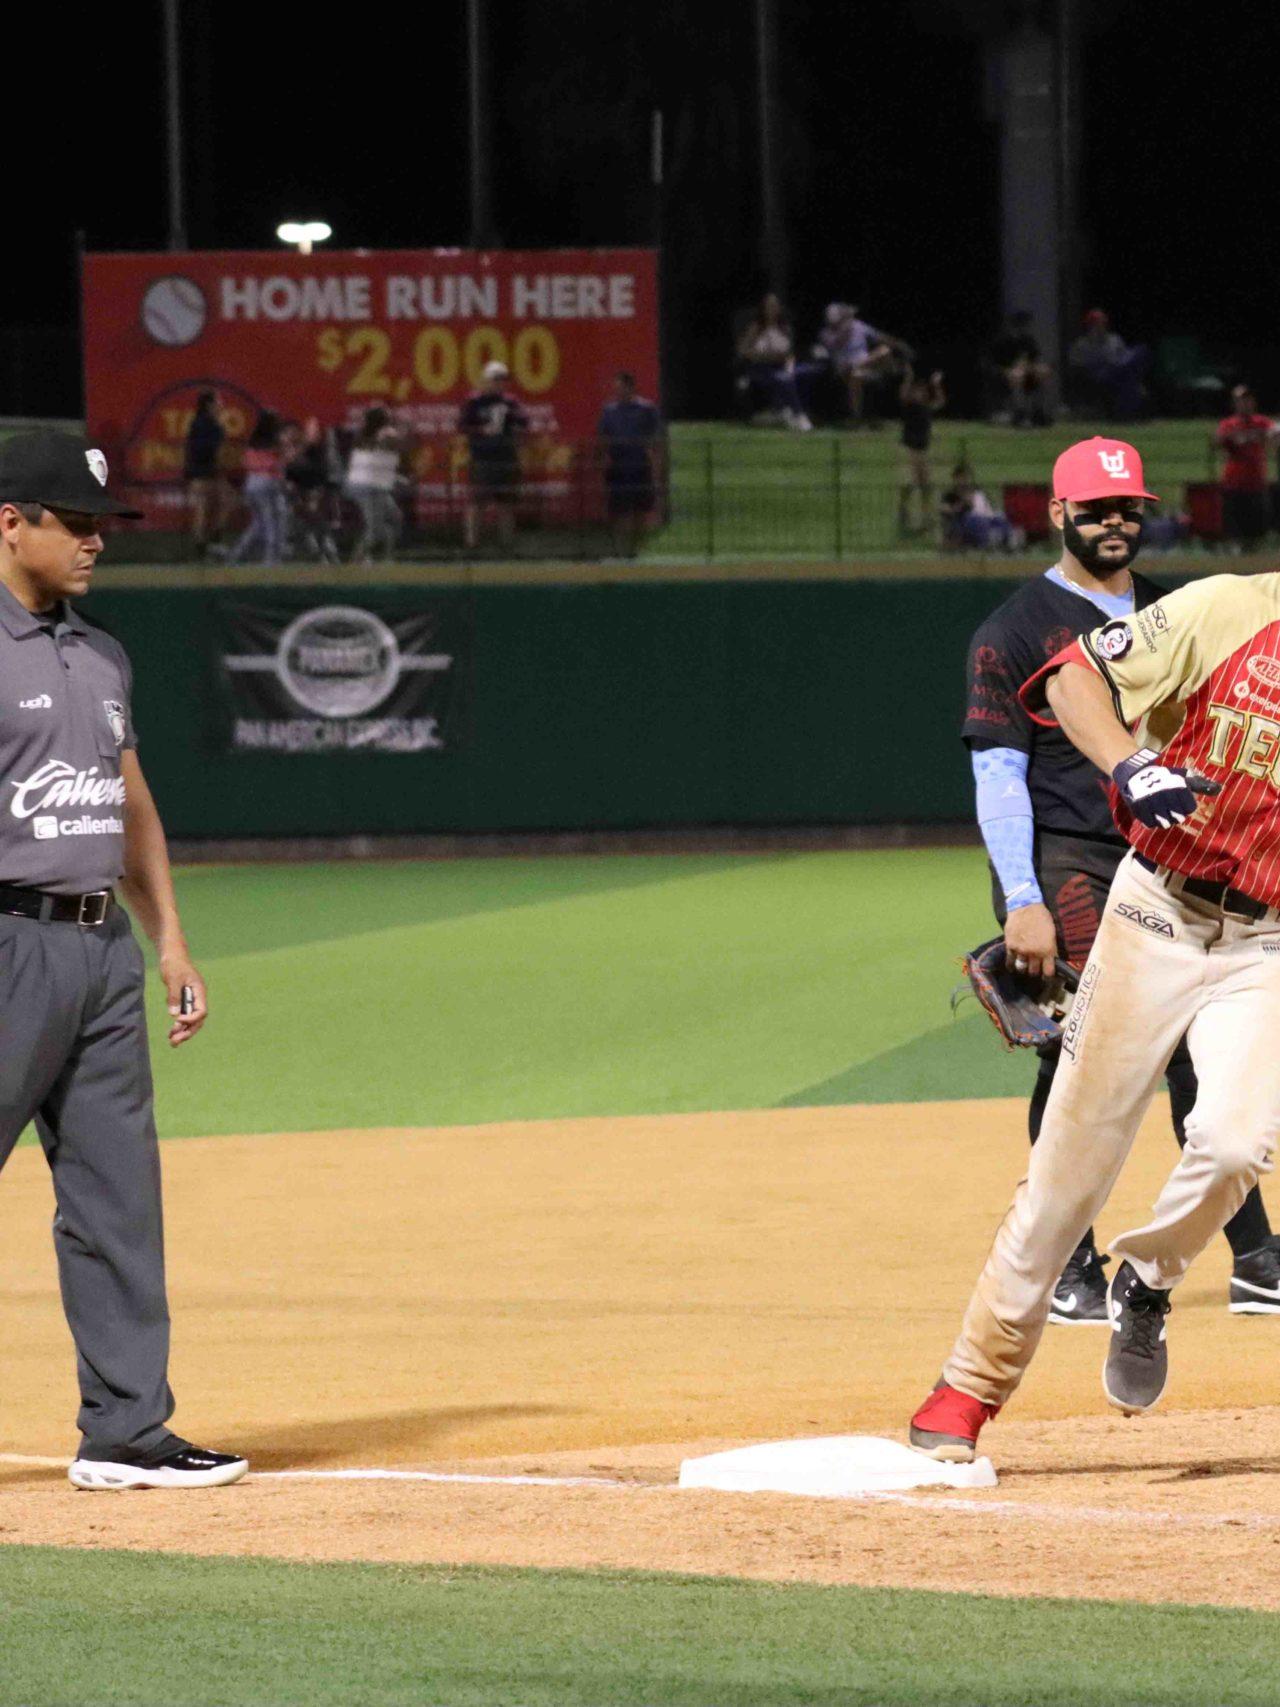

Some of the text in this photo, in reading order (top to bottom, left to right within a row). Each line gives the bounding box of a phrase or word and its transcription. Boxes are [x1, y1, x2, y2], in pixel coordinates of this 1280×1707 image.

[220, 274, 636, 320] HOME RUN HERE
[316, 326, 561, 399] $2,000
[1114, 903, 1175, 938] SAGA
